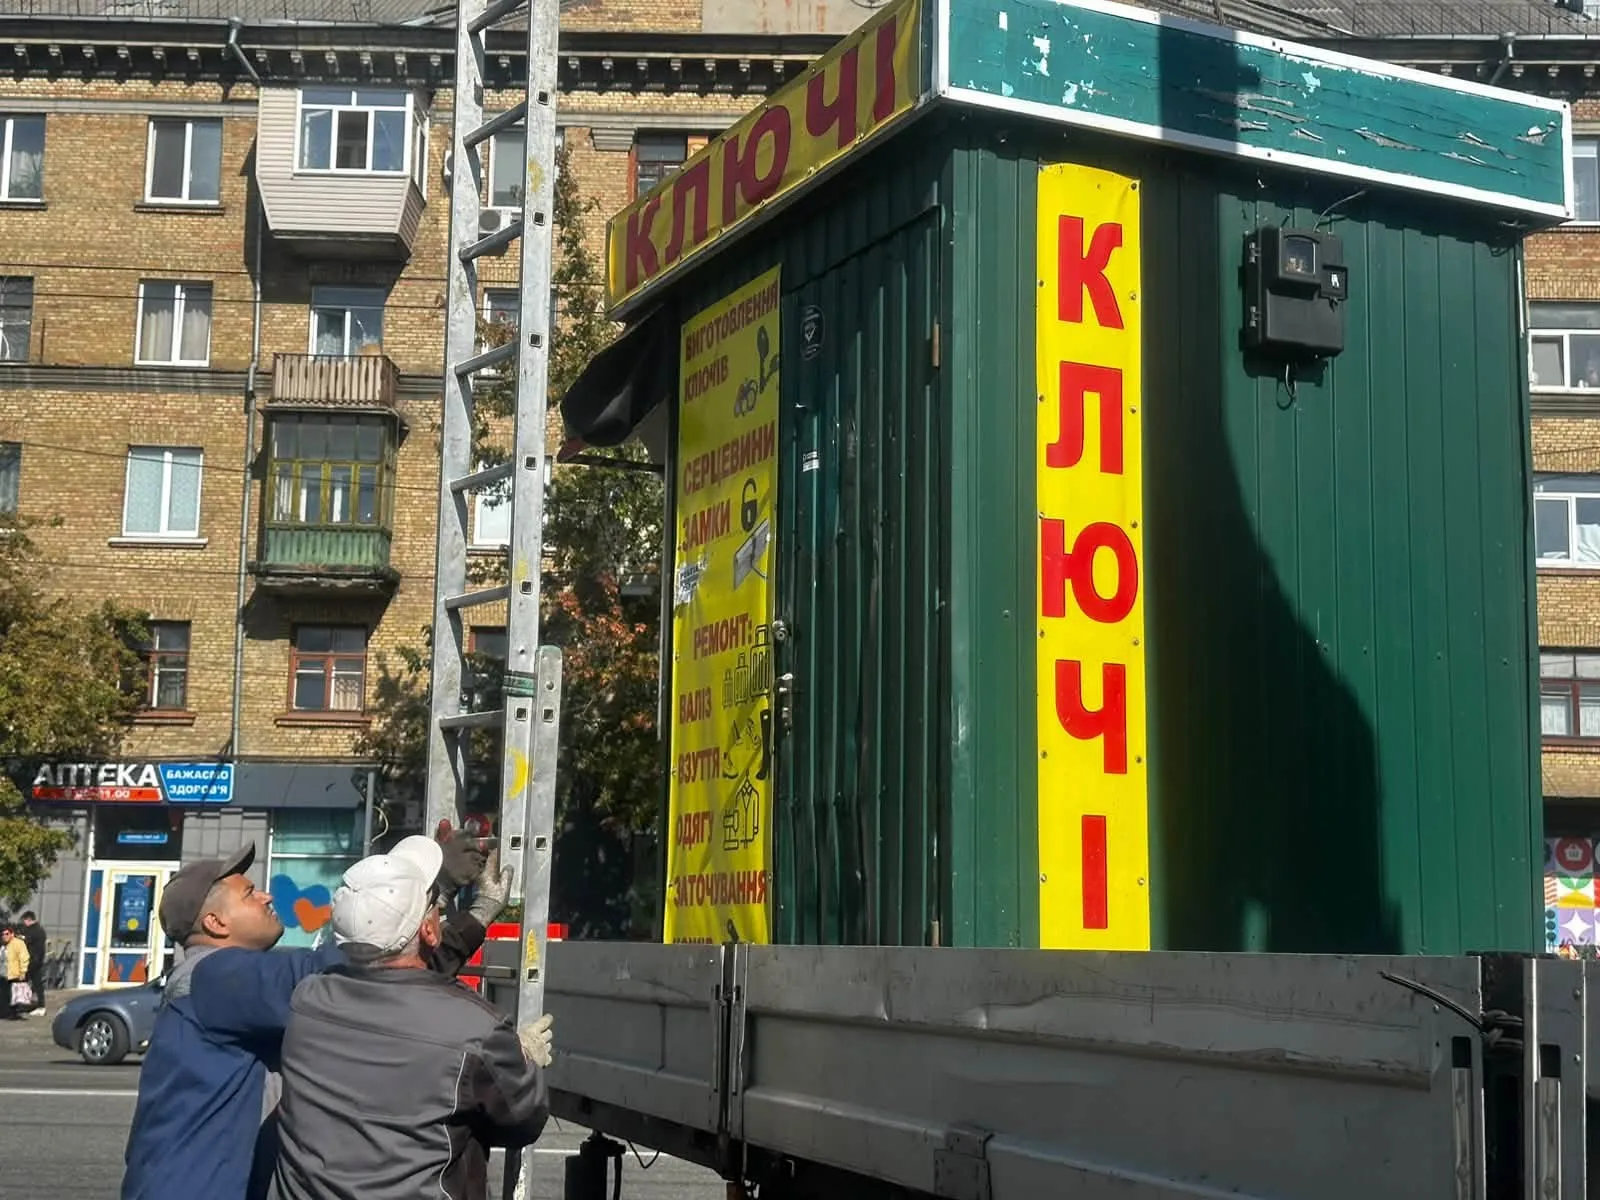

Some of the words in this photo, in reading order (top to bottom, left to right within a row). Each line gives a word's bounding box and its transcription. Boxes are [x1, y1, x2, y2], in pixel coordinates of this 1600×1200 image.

[626, 15, 896, 292] КЛЮЧІ
[685, 279, 778, 363] ВИГОТОВЛЕННЯ
[684, 354, 729, 404] КЛЮЧІВ
[683, 421, 775, 496] СЕРЦЕВИНИ
[682, 498, 731, 552] ЗАМКИ
[1041, 215, 1138, 929] КЛЮЧІ
[694, 612, 753, 660] РЕМОНТ:
[679, 686, 712, 725] ВАЛІЗ
[33, 763, 159, 786] АПТЕКА
[678, 746, 720, 784] ВЗУТТЯ
[677, 810, 714, 850] ОДЯГУ
[673, 869, 768, 907] ЗАТОЧУВАННЯ
